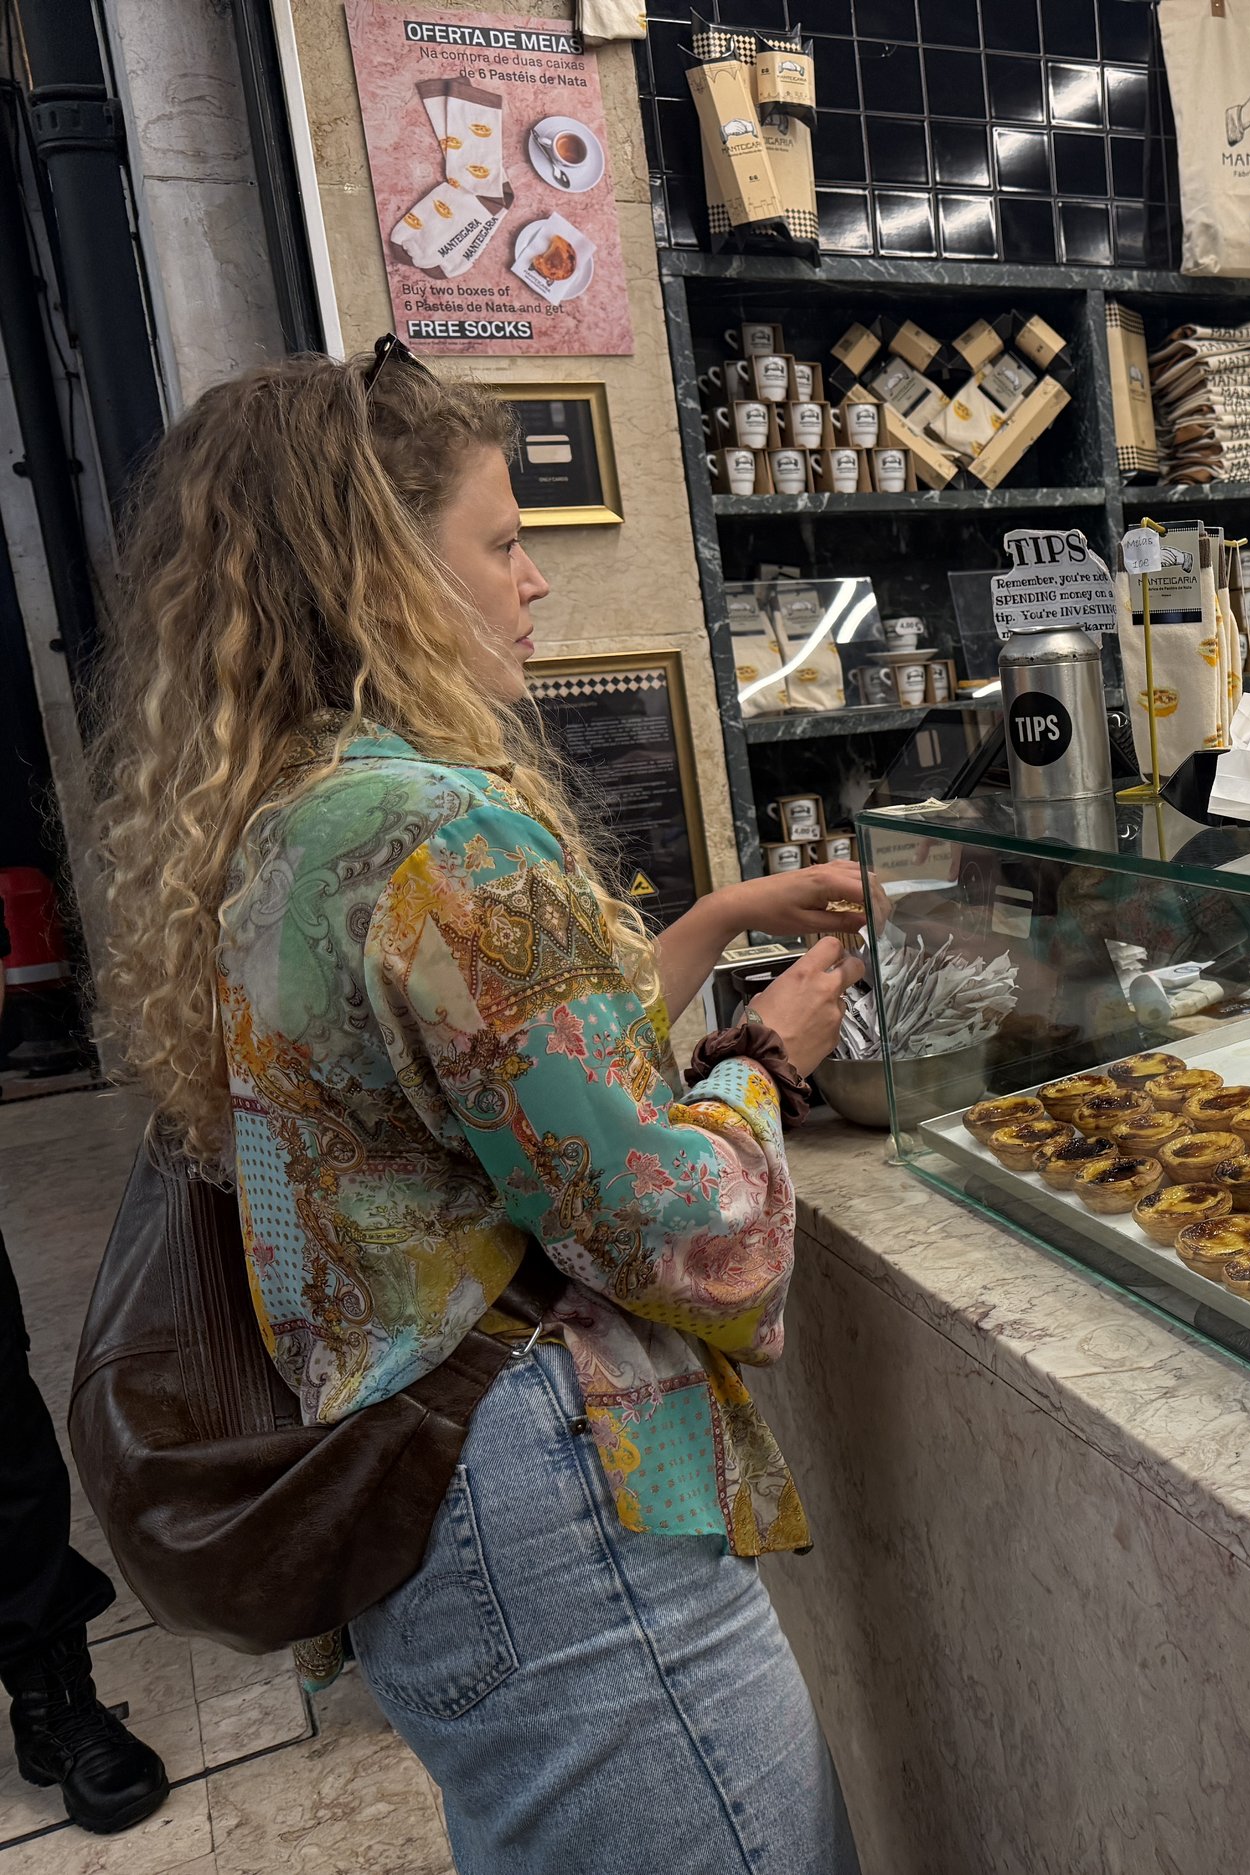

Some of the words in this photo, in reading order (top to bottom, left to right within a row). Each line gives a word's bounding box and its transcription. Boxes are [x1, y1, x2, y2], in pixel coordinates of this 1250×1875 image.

[406, 23, 486, 46] OFERTA
[489, 33, 517, 49] DE
[521, 36, 583, 54] MEIAS
[419, 47, 438, 58] Na
[441, 50, 490, 67] compra
[493, 52, 509, 64] de
[513, 55, 542, 68] duas
[546, 58, 585, 70] caixas
[460, 66, 475, 78] de
[478, 69, 486, 79] 6
[490, 68, 536, 84] Pastéis
[539, 72, 555, 85] de
[557, 74, 588, 88] Nata
[438, 219, 482, 258] MANTEIGARIA
[402, 284, 426, 298] Buy
[430, 286, 454, 296] two
[457, 285, 494, 296] boxes
[498, 286, 510, 296] of
[404, 301, 413, 312] 6
[416, 300, 464, 312] Pastéis
[466, 302, 482, 312] de
[486, 302, 516, 313] Nata
[520, 304, 542, 314] and
[545, 304, 564, 316] get
[408, 321, 461, 336] FREE
[464, 321, 532, 337] SOCKS
[1008, 534, 1087, 566] TIPS
[996, 576, 1058, 589] Remember,
[1058, 572, 1090, 586] you're
[996, 591, 1056, 606] SPENDING
[1060, 590, 1092, 601] money
[1095, 590, 1107, 598] on
[1108, 590, 1114, 598] a
[995, 612, 1016, 624] tip.
[1020, 608, 1058, 620] You're
[1015, 714, 1060, 742] TIPS
